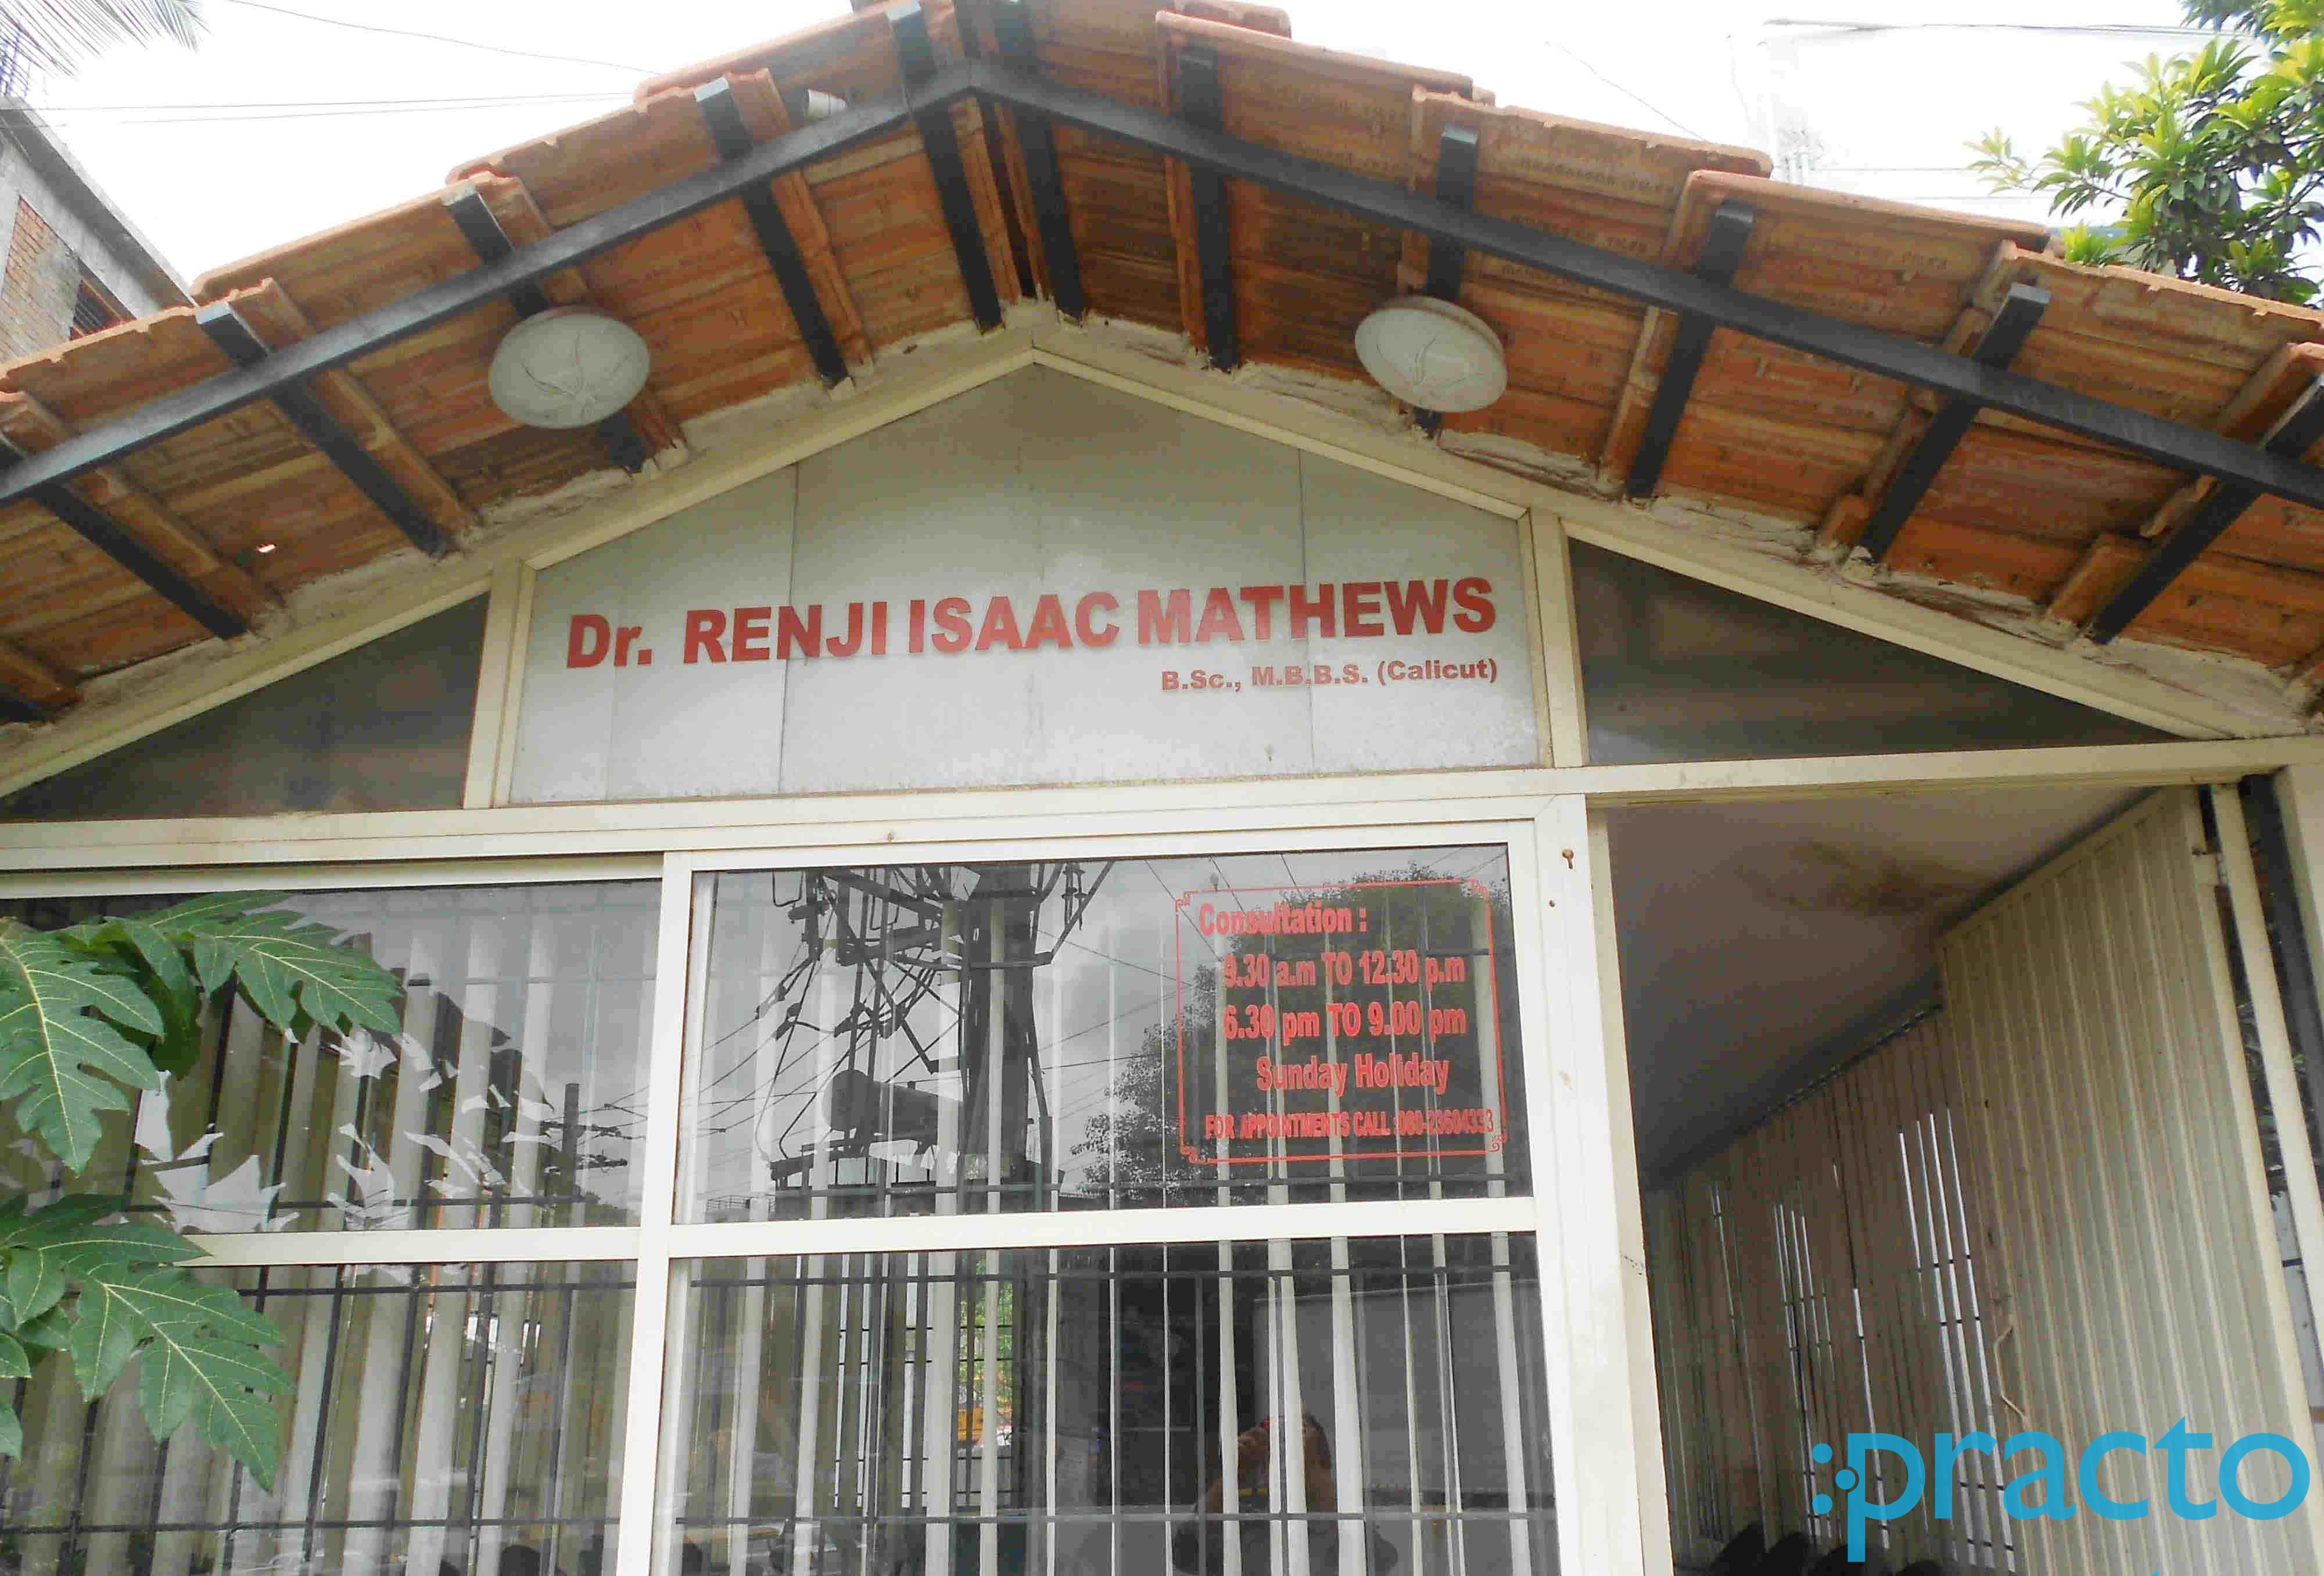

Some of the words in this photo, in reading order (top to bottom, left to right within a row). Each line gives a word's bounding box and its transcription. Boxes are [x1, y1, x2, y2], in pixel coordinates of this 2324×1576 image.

[566, 613, 652, 669] Dr.
[683, 600, 887, 664] RENJI
[908, 590, 1120, 654] ISAAC
[1137, 576, 1497, 644] MATHEWS
[1162, 669, 1241, 692] B.Sc.,
[1251, 664, 1369, 686] M.B.B.S.
[1376, 658, 1497, 686] (Calicut)
[1199, 901, 1352, 936] Consultation
[1322, 951, 1353, 986] TO
[1359, 949, 1419, 984] 12.30
[1223, 1004, 1275, 1040] 6.30
[1282, 1010, 1321, 1046] pm
[1326, 1002, 1361, 1037] TO
[1368, 1001, 1422, 1036] 9.00
[1428, 1008, 1468, 1042] pm
[1256, 1055, 1348, 1097] Sunday
[1354, 1052, 1450, 1095] Holiday
[1205, 1114, 1236, 1140] FOR
[1240, 1112, 1351, 1139] APPOINTMENTS
[1354, 1111, 1391, 1137] CALL
